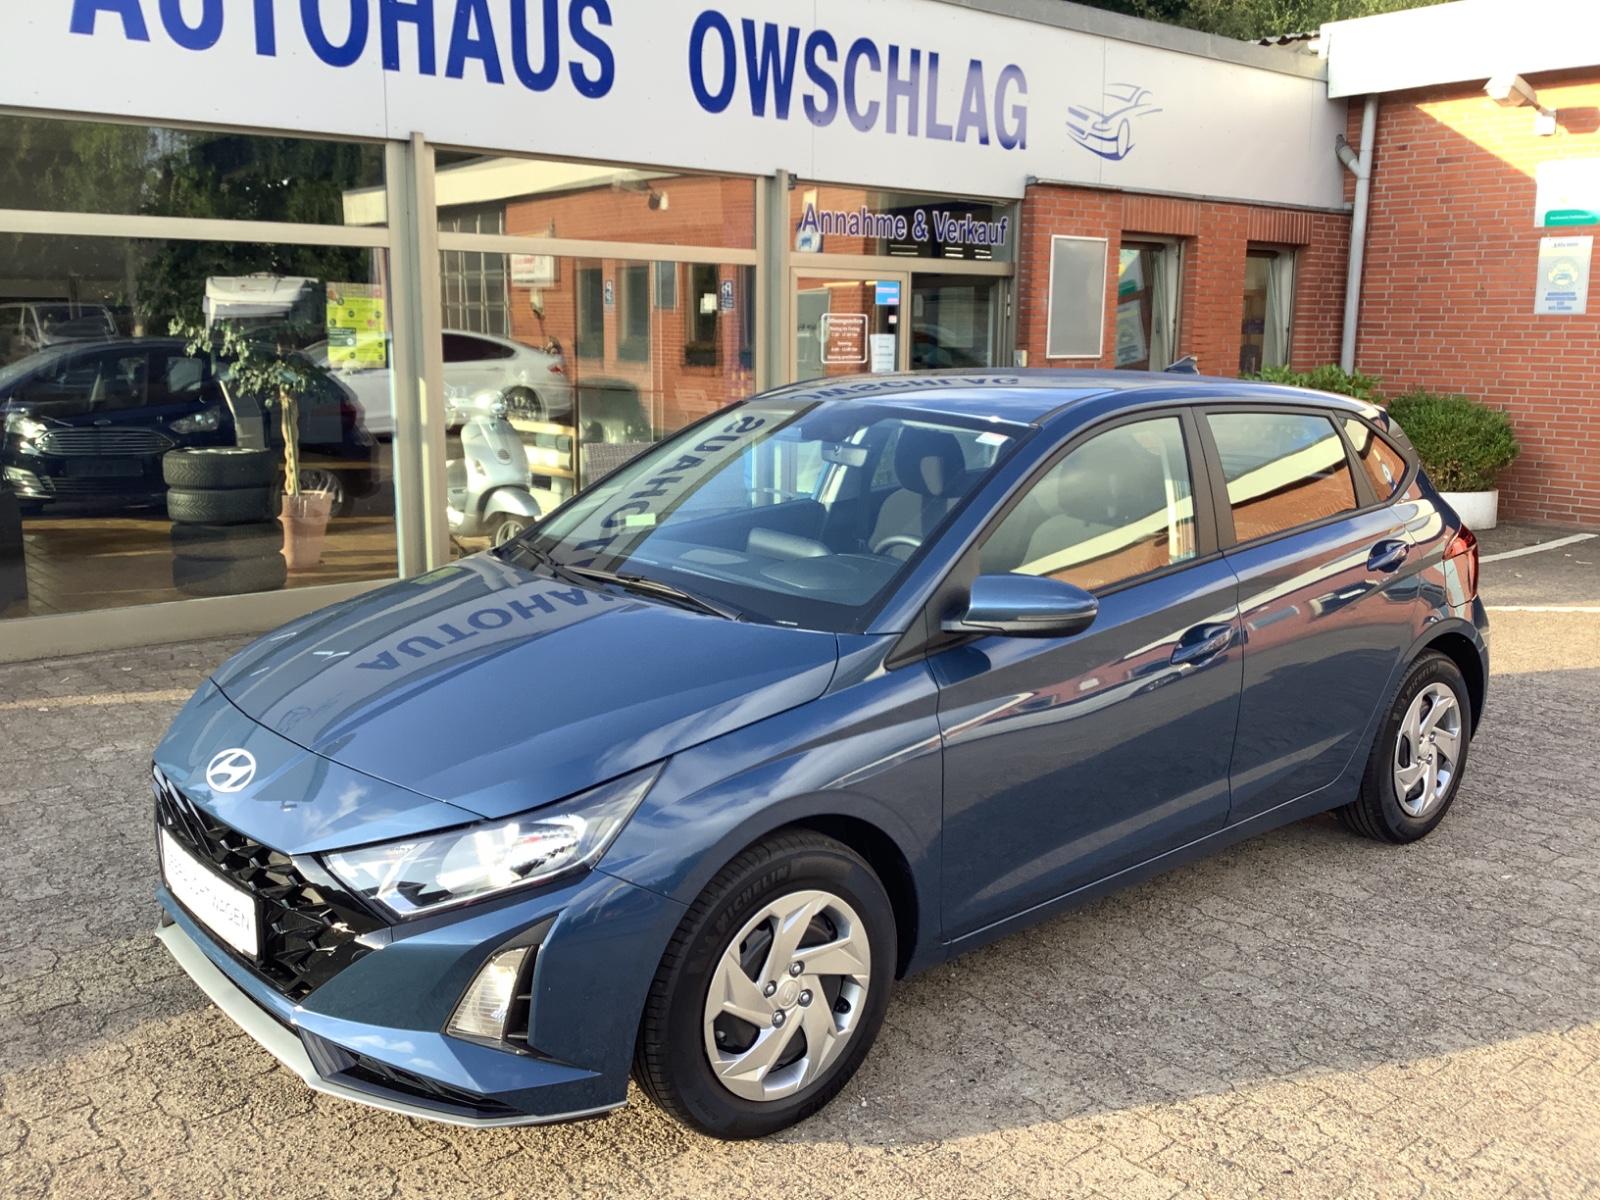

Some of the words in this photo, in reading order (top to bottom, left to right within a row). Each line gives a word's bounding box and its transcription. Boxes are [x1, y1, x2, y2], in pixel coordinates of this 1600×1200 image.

[69, 0, 615, 99] OHAUS
[688, 9, 1028, 151] OWSCHLAG
[802, 202, 907, 240] Annahme
[912, 208, 929, 243] &
[932, 209, 1008, 247] Verkauf
[715, 863, 790, 934] MICHELIN
